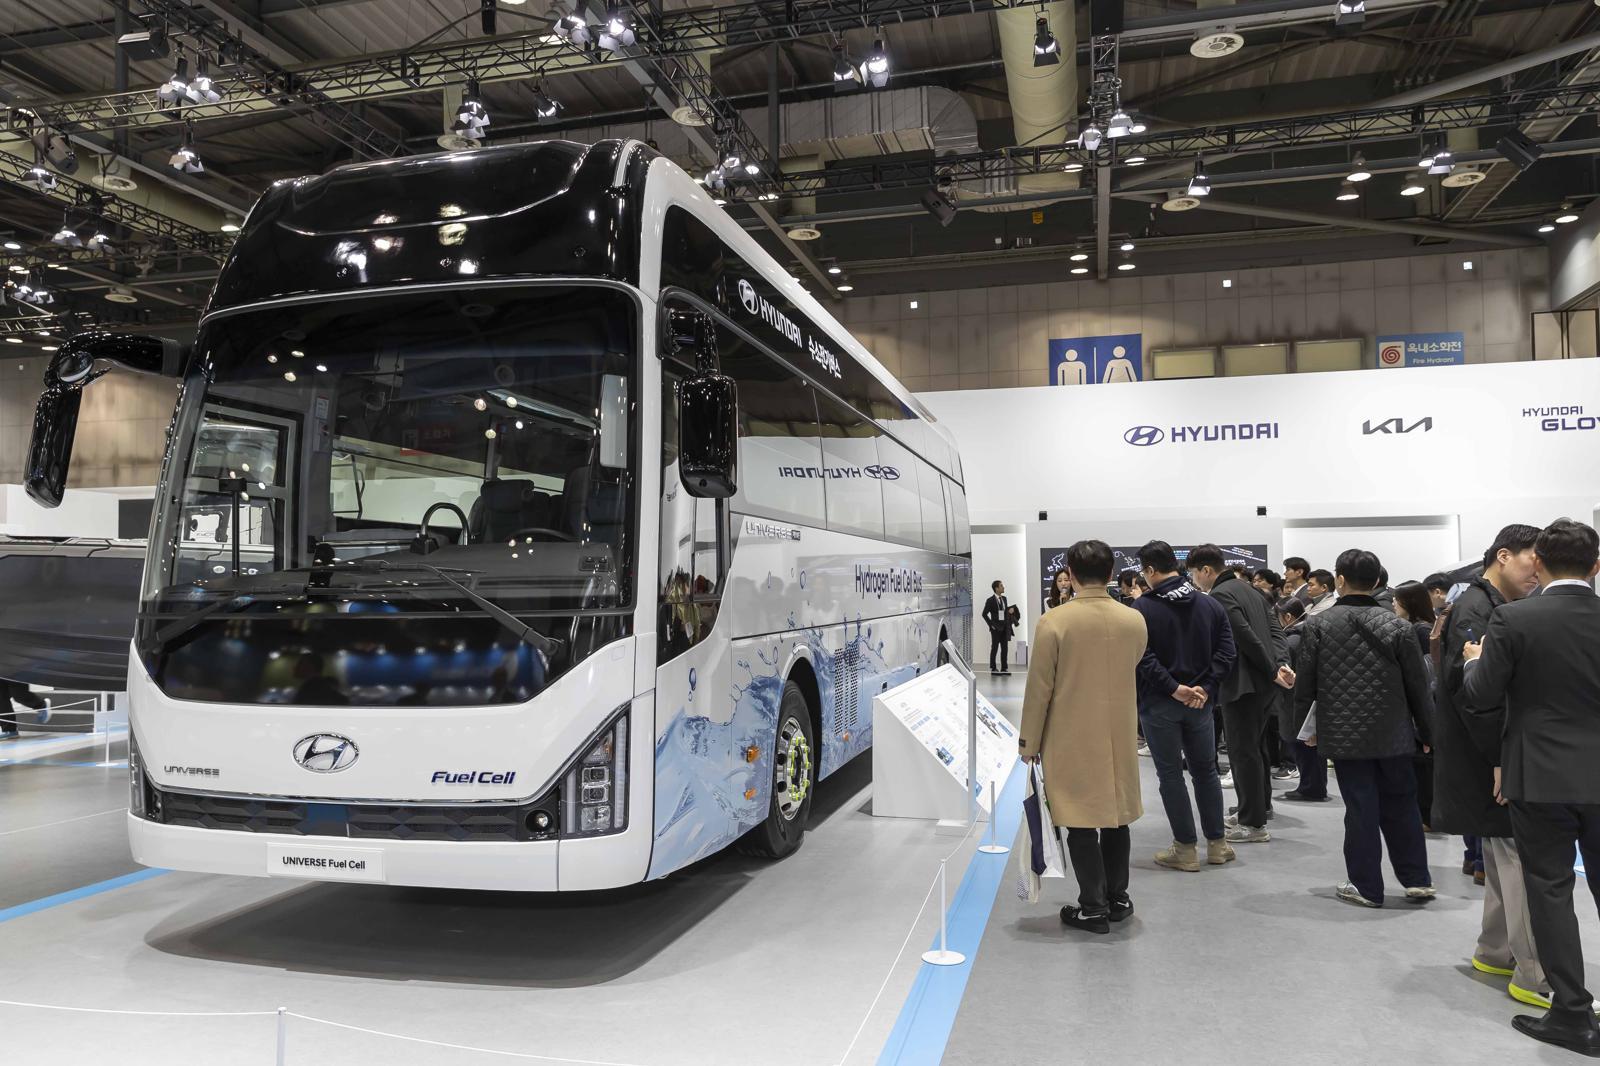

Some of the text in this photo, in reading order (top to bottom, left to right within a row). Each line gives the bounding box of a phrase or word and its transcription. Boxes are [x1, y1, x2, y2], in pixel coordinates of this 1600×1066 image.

[759, 296, 802, 348] HYUNDAI
[1407, 341, 1462, 353] 옥내소화전
[809, 335, 842, 379] 수소전기버스
[1426, 357, 1454, 365] Hydrant
[1522, 405, 1583, 417] HYUNDAI
[1541, 417, 1600, 431] GLO
[1171, 422, 1279, 442] HYUNDAI
[855, 564, 922, 600] Hydrogen Fuel Cell Bus
[163, 765, 220, 776] UNIVERSE
[431, 771, 516, 785] Fuel Cell
[282, 856, 366, 869] UNIVERSE Fuel Cell
